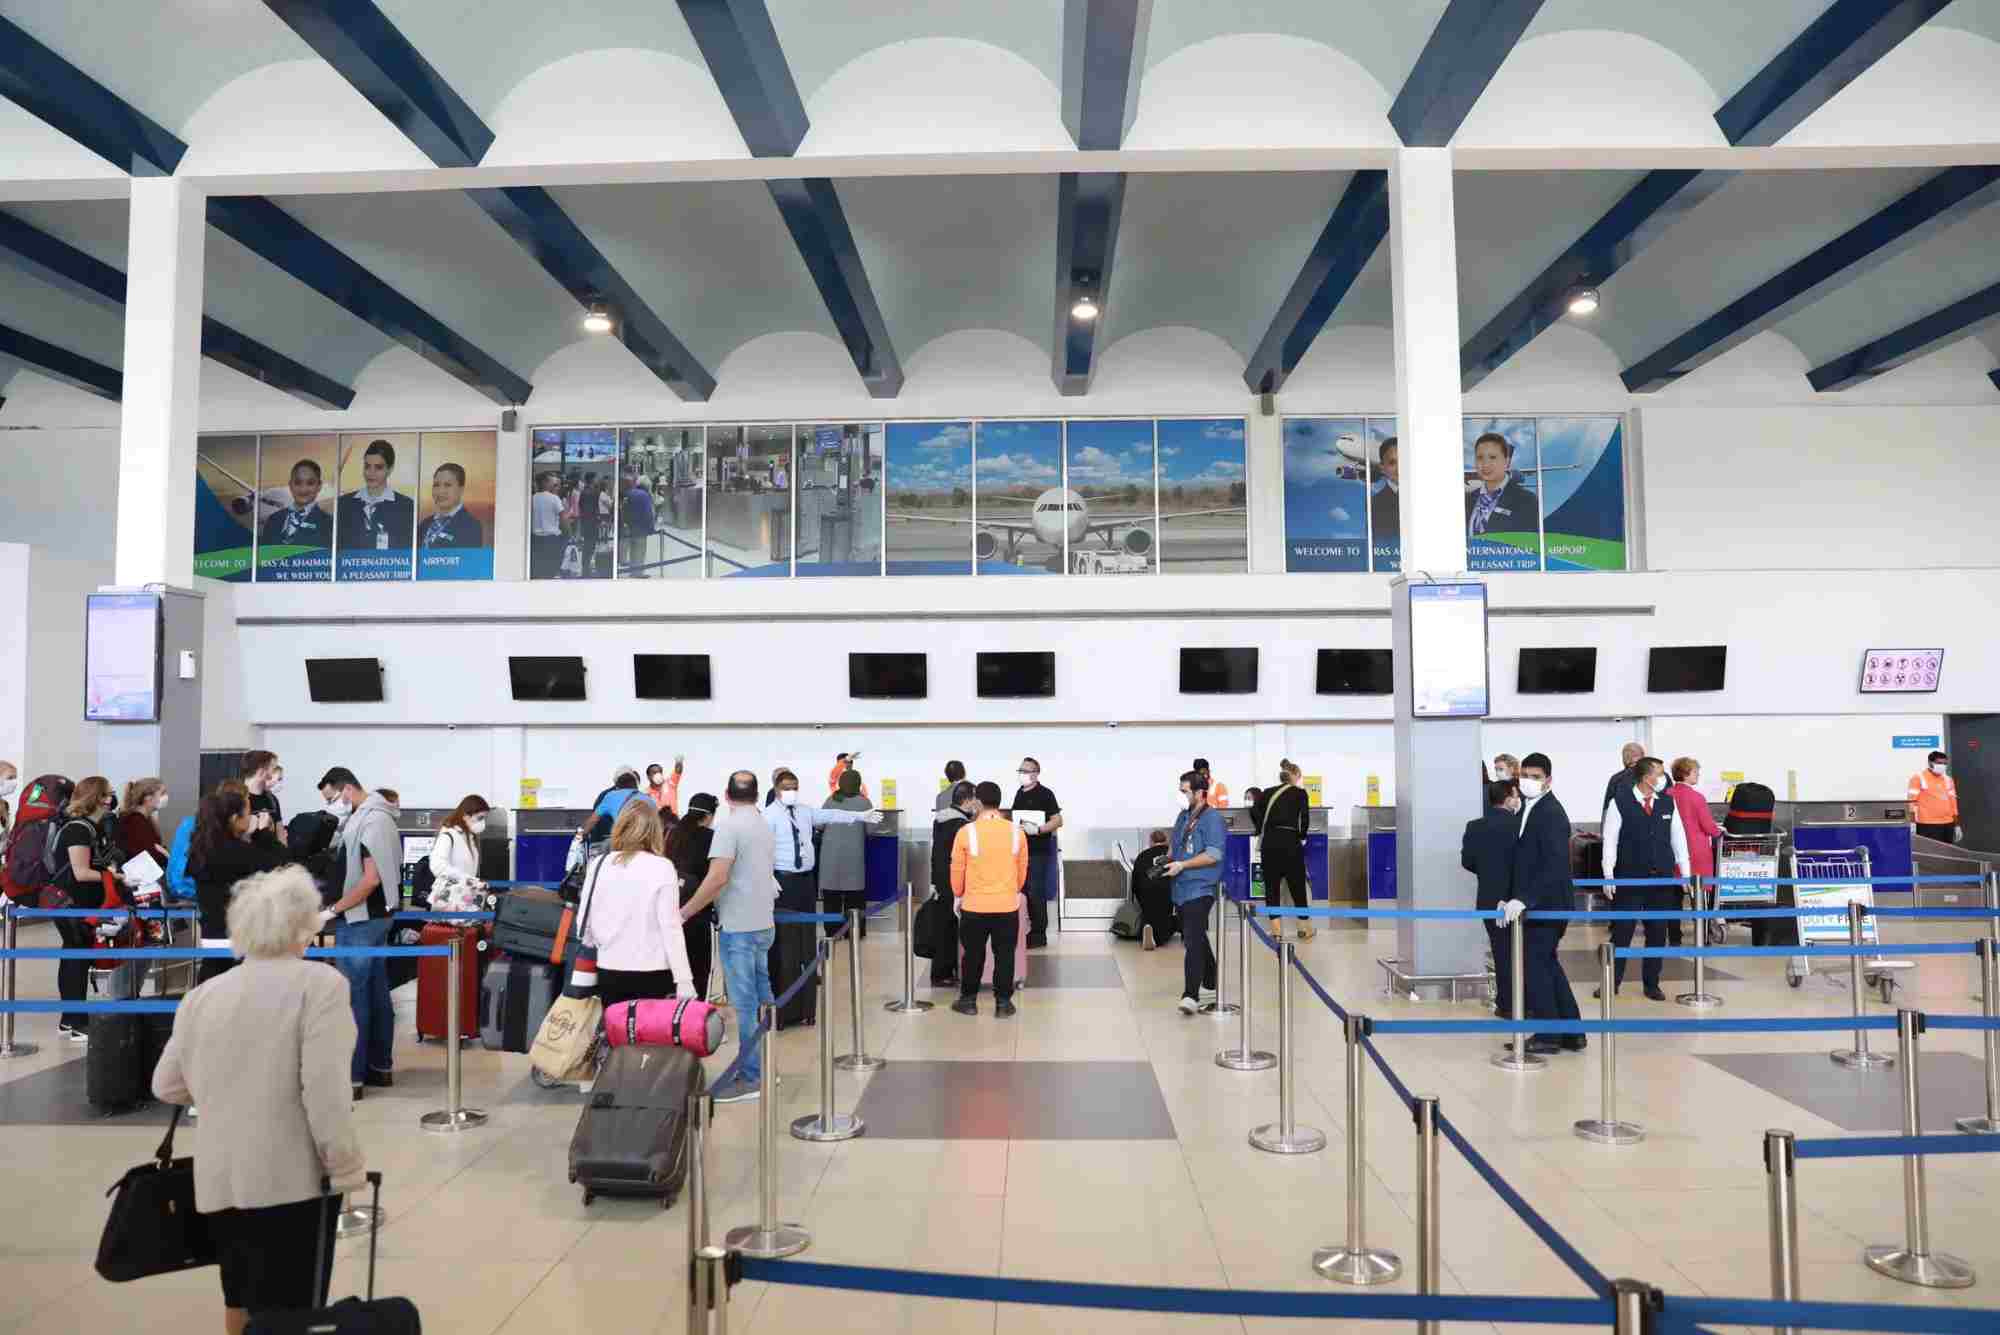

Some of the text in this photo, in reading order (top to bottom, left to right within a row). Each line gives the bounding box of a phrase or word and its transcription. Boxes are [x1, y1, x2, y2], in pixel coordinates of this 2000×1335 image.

[1294, 546, 1360, 556] WELCOME TO
[1466, 546, 1536, 556] NTERNATIONAL
[342, 557, 409, 567] INTERNATIONAL
[423, 556, 460, 566] AIRPORT
[1471, 559, 1537, 569] PLEASANT TRIP
[292, 571, 312, 580] WISH
[349, 571, 390, 580] PLEASANT
[393, 571, 411, 580] TRIP
[1848, 807, 1855, 818] 2
